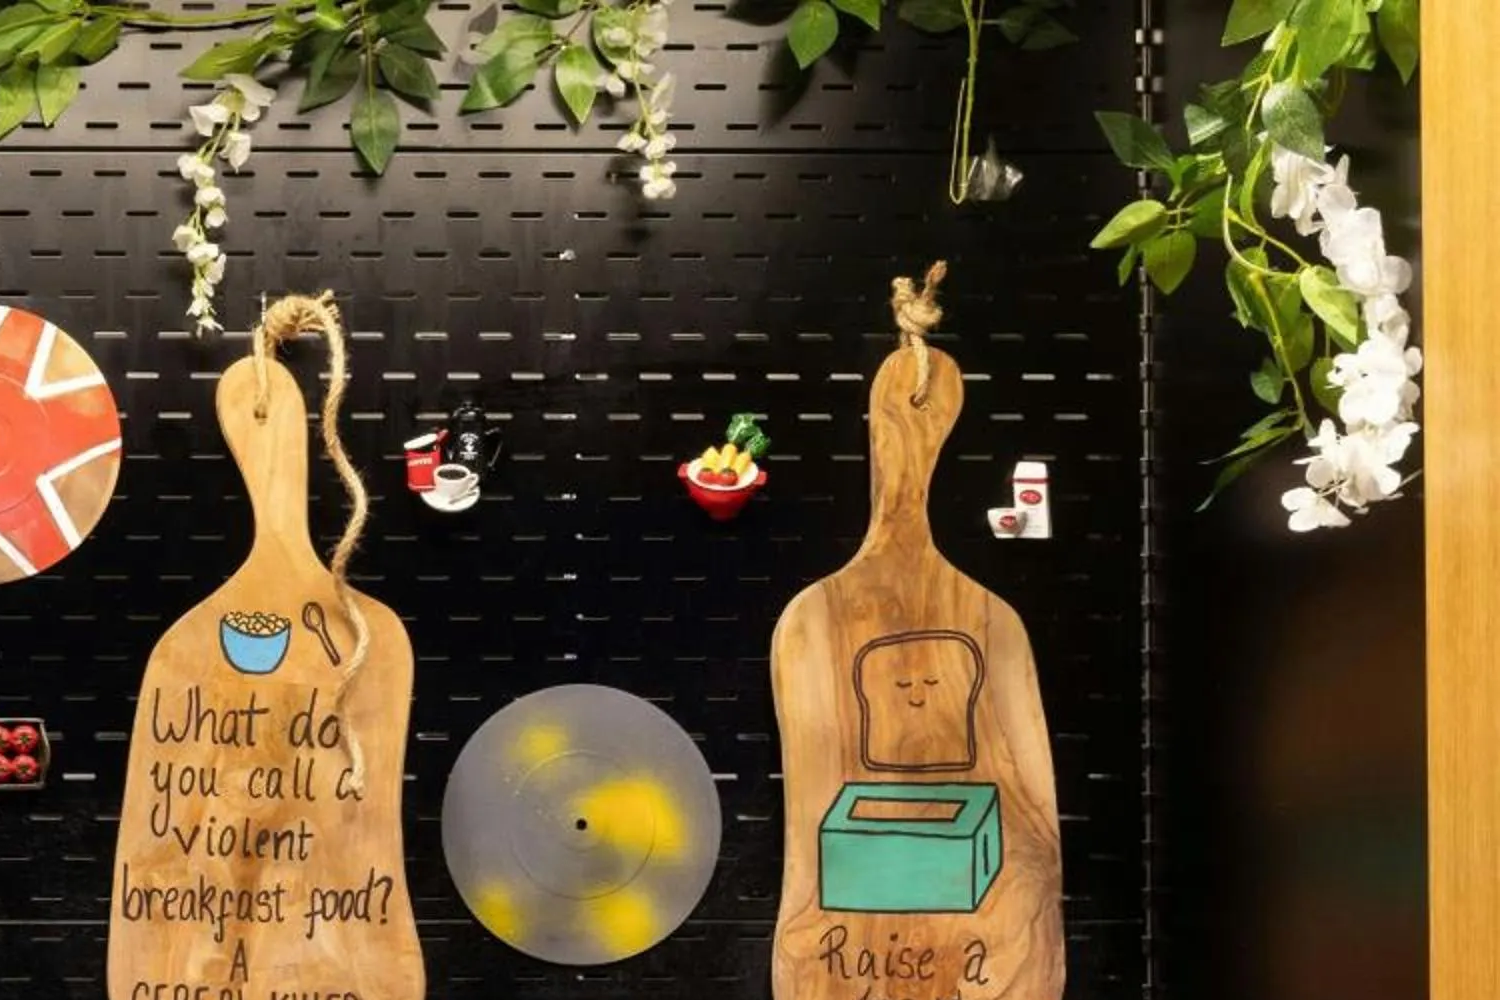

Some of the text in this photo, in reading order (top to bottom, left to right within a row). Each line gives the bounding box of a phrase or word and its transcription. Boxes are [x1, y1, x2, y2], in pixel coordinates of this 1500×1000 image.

[151, 685, 342, 749] What do
[150, 757, 364, 838] you call a
[172, 816, 315, 862] violent
[121, 862, 394, 944] breakfast food?
[229, 938, 249, 983] A
[819, 924, 990, 986] Raise a
